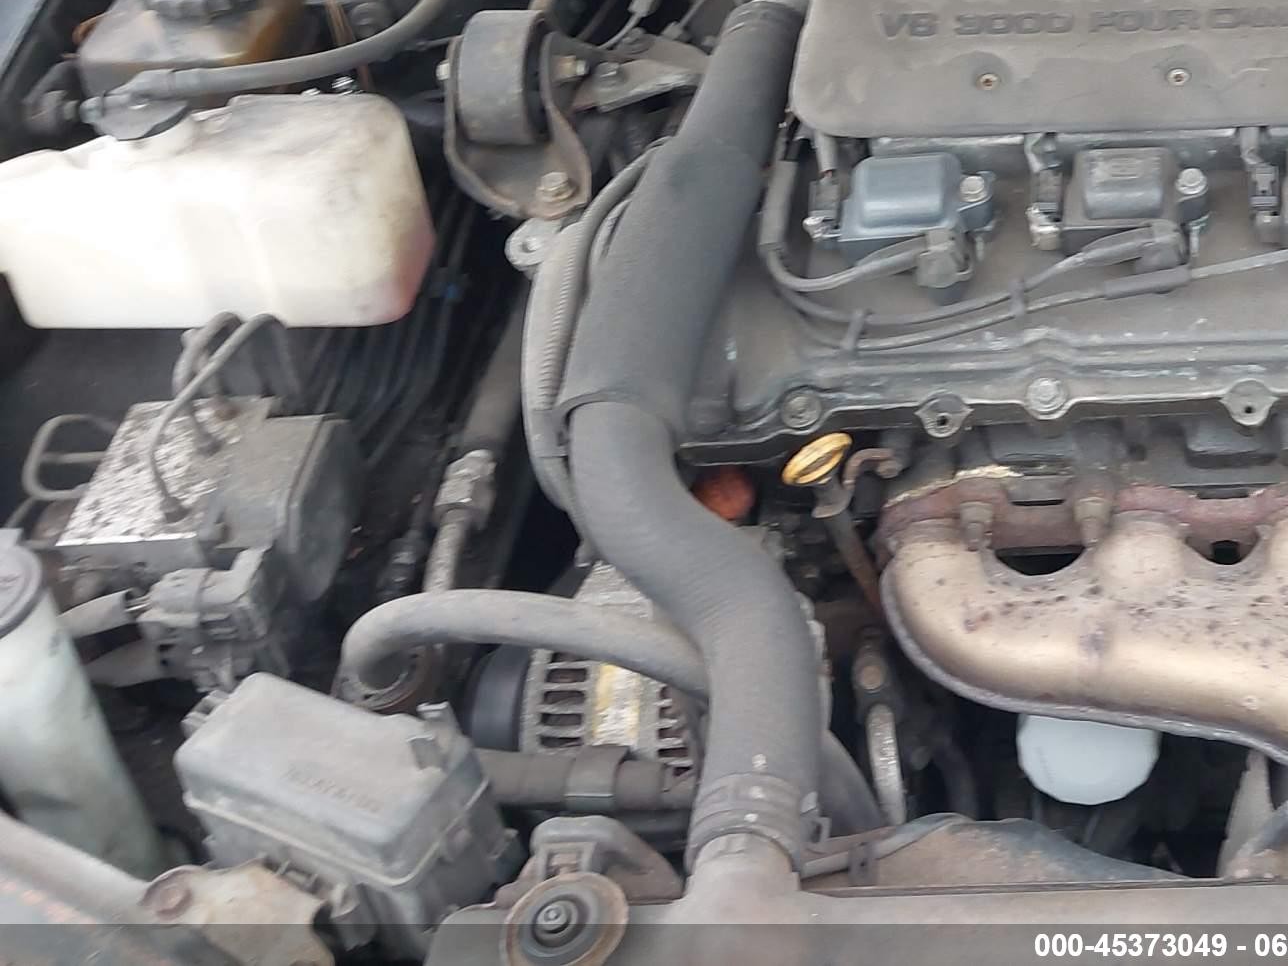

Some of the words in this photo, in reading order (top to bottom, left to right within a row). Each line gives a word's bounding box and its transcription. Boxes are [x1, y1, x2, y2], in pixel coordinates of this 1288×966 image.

[877, 11, 938, 38] V6
[954, 10, 1075, 36] 3000
[1089, 8, 1201, 34] FOUR
